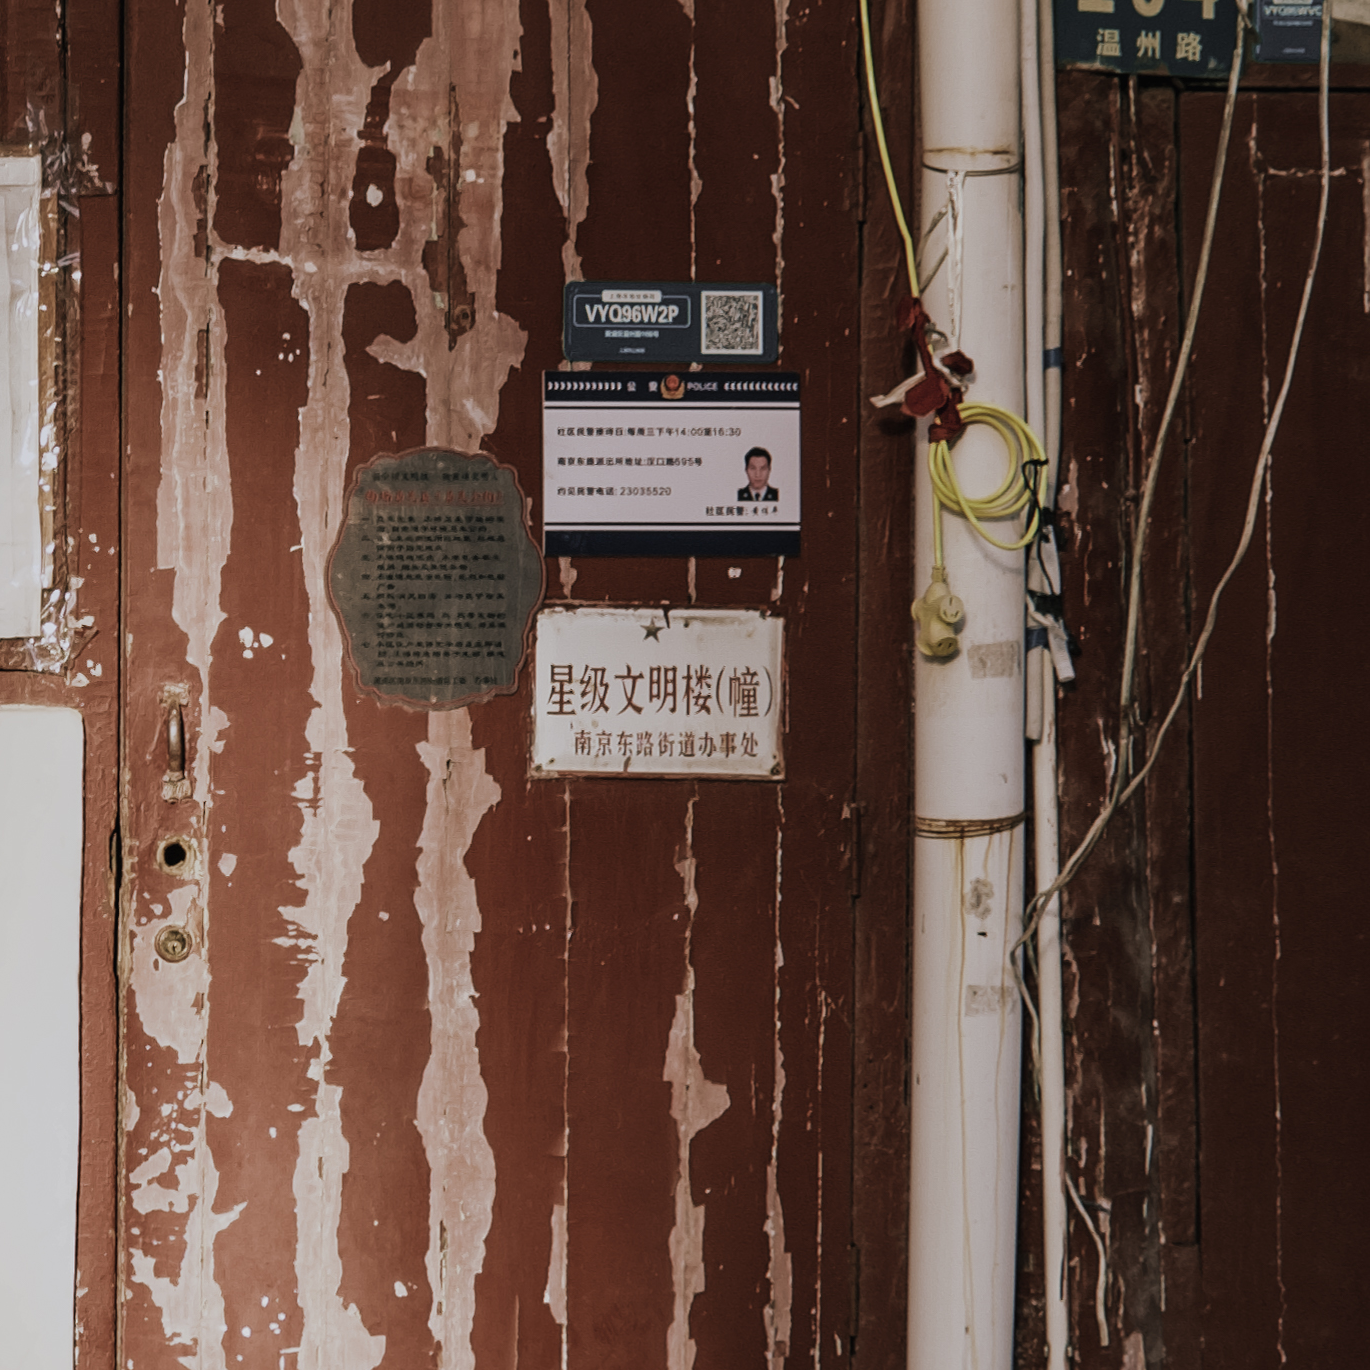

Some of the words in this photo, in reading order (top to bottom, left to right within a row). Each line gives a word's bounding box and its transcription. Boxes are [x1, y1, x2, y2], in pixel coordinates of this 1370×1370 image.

[1096, 29, 1203, 62] 温州路
[585, 303, 680, 323] VYQ96W2P
[574, 730, 759, 759] 南京东路街道办事处
